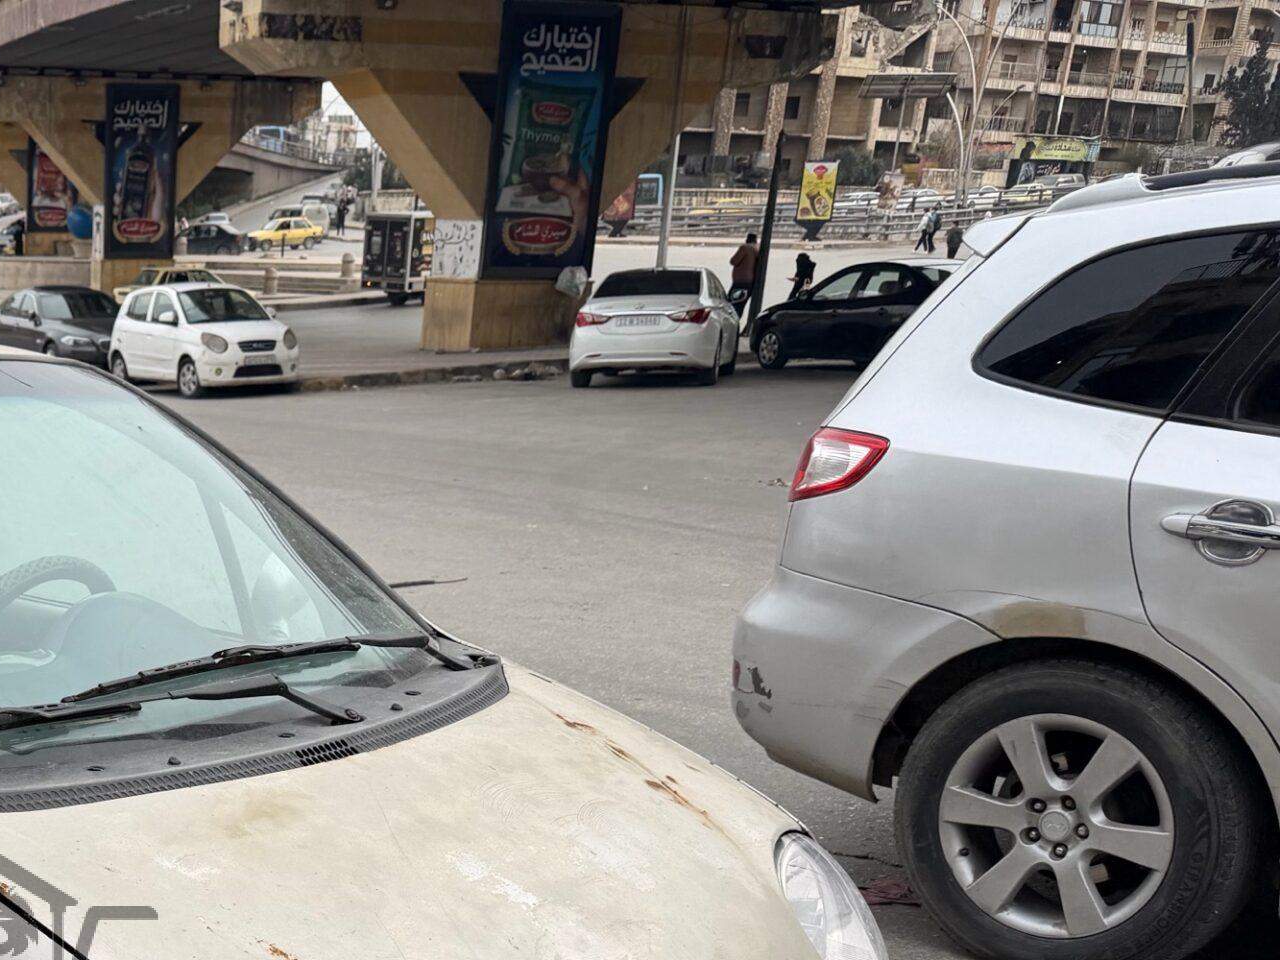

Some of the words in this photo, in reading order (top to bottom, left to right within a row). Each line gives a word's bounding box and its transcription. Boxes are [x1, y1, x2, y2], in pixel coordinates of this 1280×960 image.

[524, 24, 601, 54] اختيارك
[520, 48, 596, 76] الصحيح
[114, 99, 168, 117] اختيارك
[113, 114, 166, 131] الصحيح
[520, 127, 561, 145] Thyme
